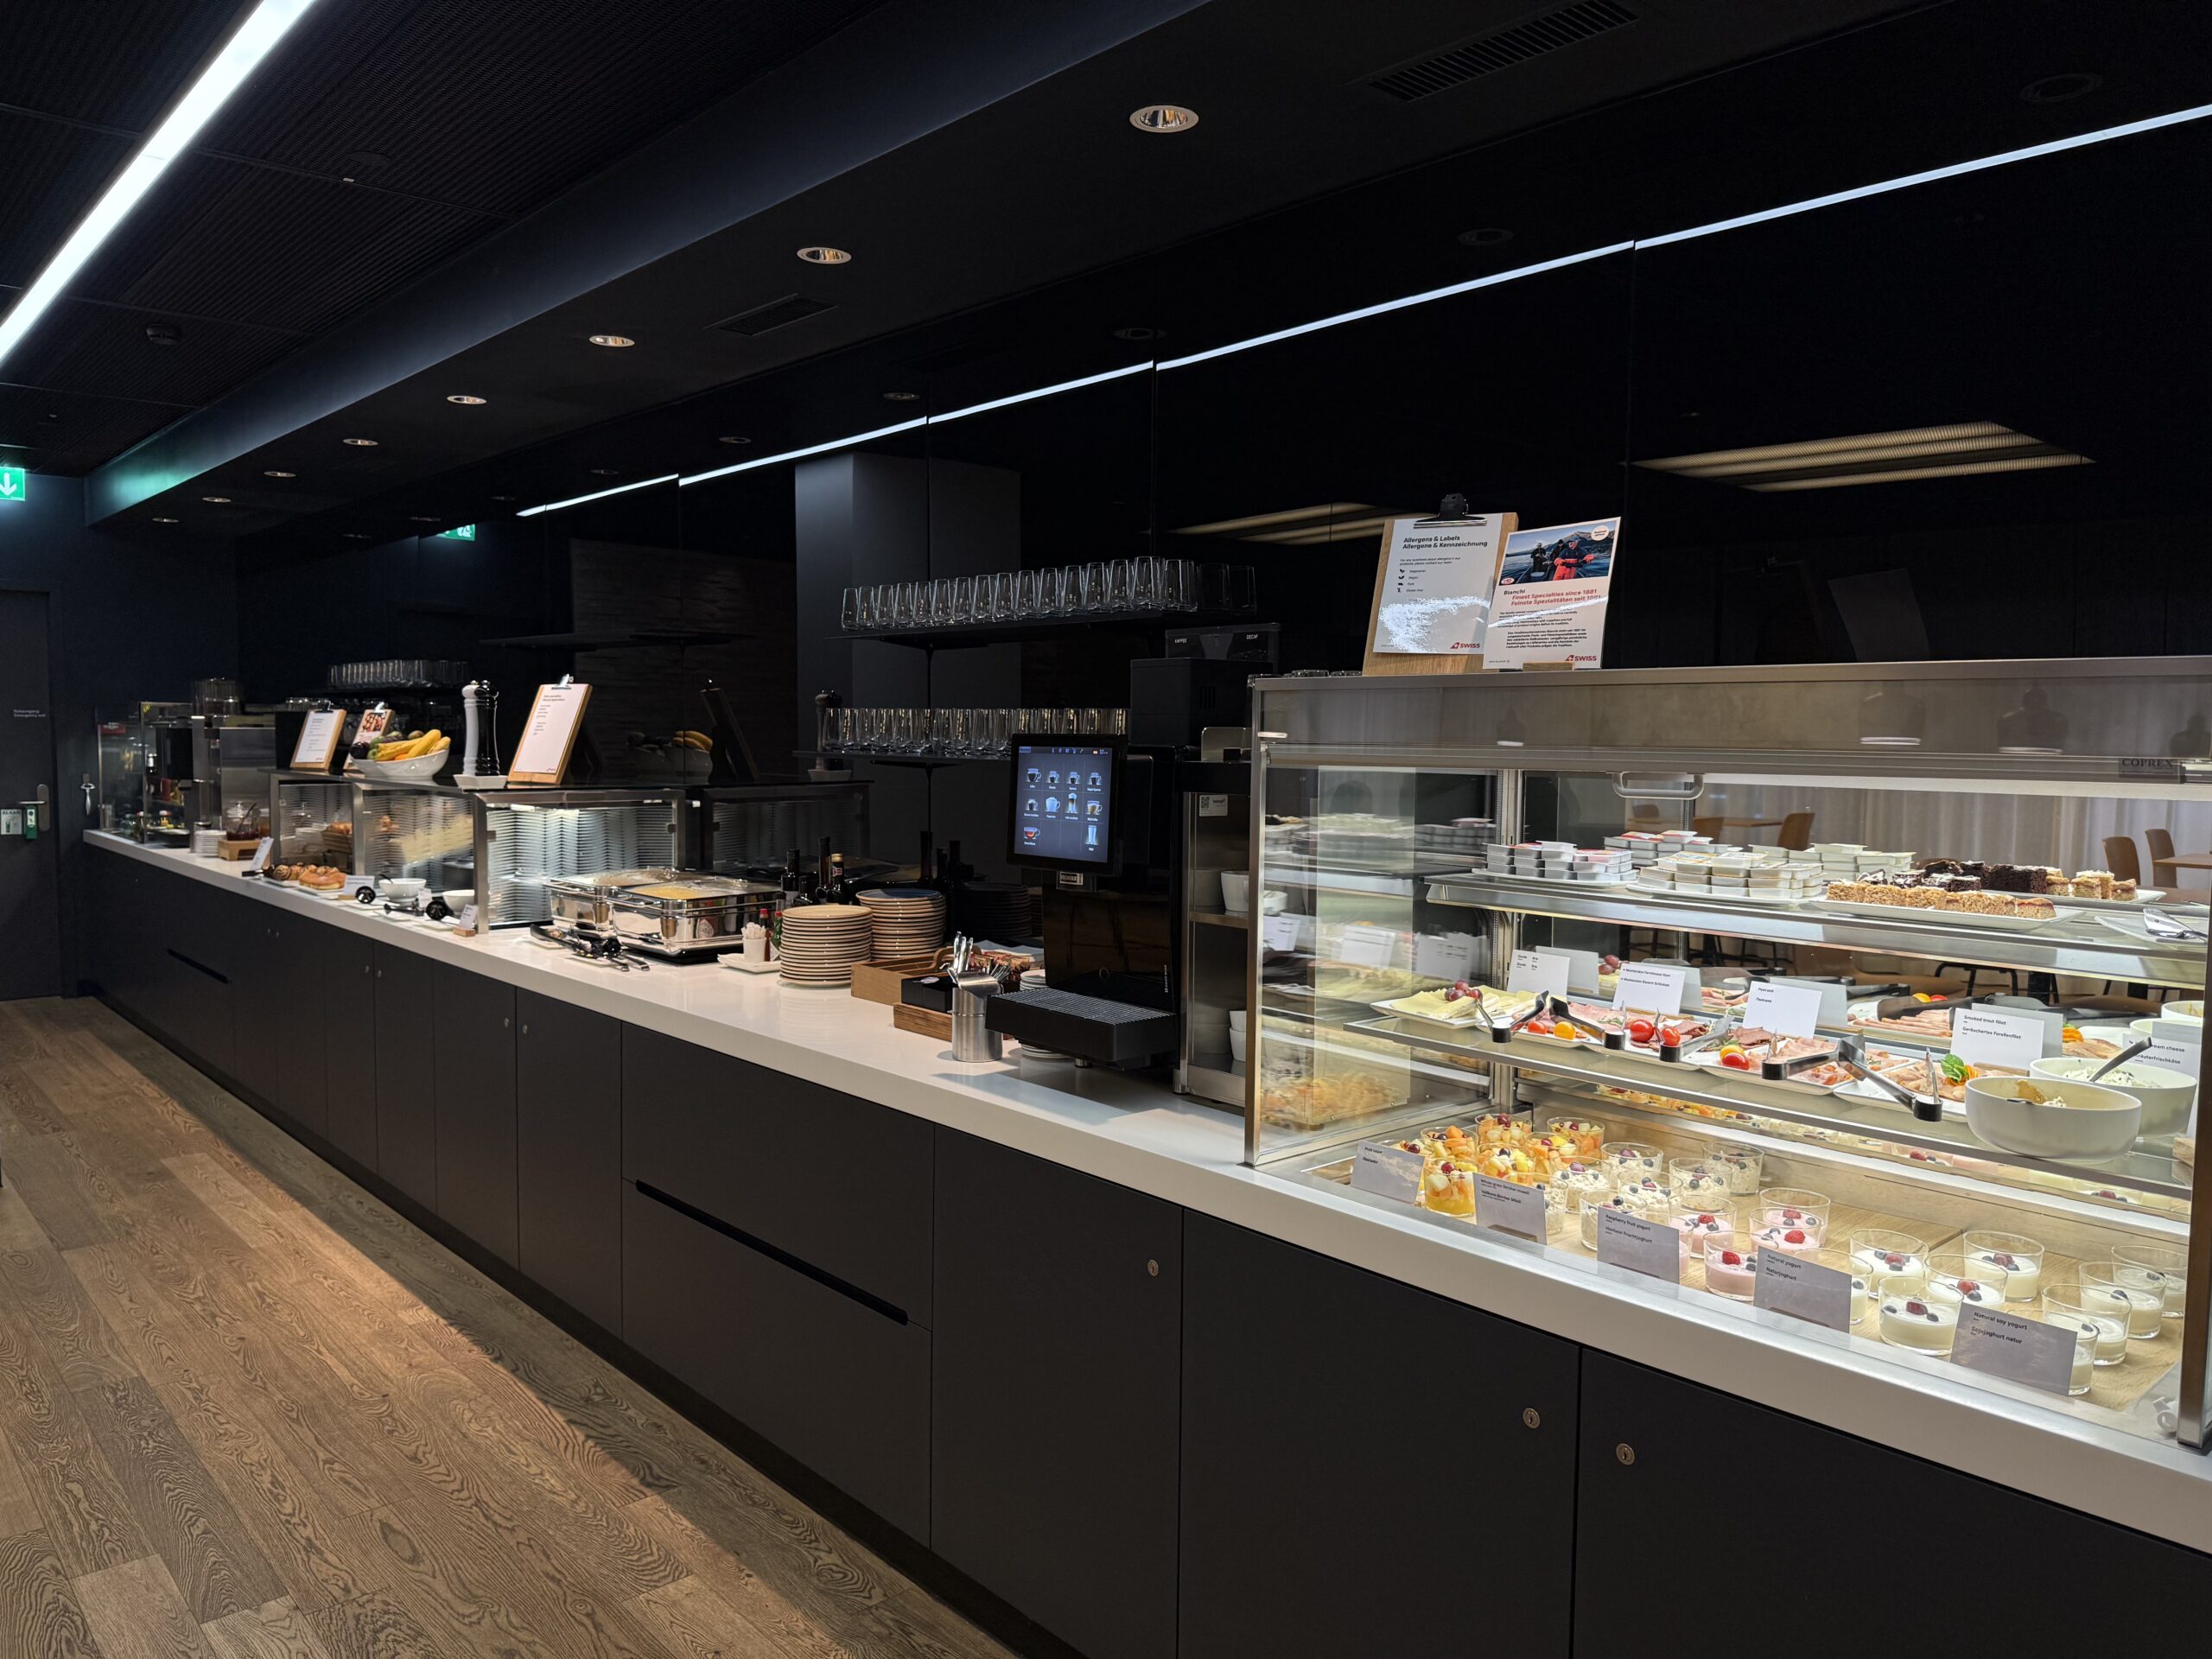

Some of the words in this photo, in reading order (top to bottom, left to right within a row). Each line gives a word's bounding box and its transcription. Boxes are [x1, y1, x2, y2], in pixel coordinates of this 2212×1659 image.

[1534, 597, 1573, 606] Spezialitäten
[1962, 1026, 1993, 1035] Geräuchertes
[1605, 1214, 1626, 1224] Raspberry
[1767, 1253, 1784, 1263] Natural
[1785, 1261, 1802, 1269] yogurt
[1765, 1267, 1796, 1281] Naturjoghurt
[1974, 1312, 1995, 1321] Natural
[2007, 1321, 2027, 1331] yogurt
[1971, 1325, 2005, 1340] Sojajoghurt
[2005, 1336, 2022, 1344] natur
